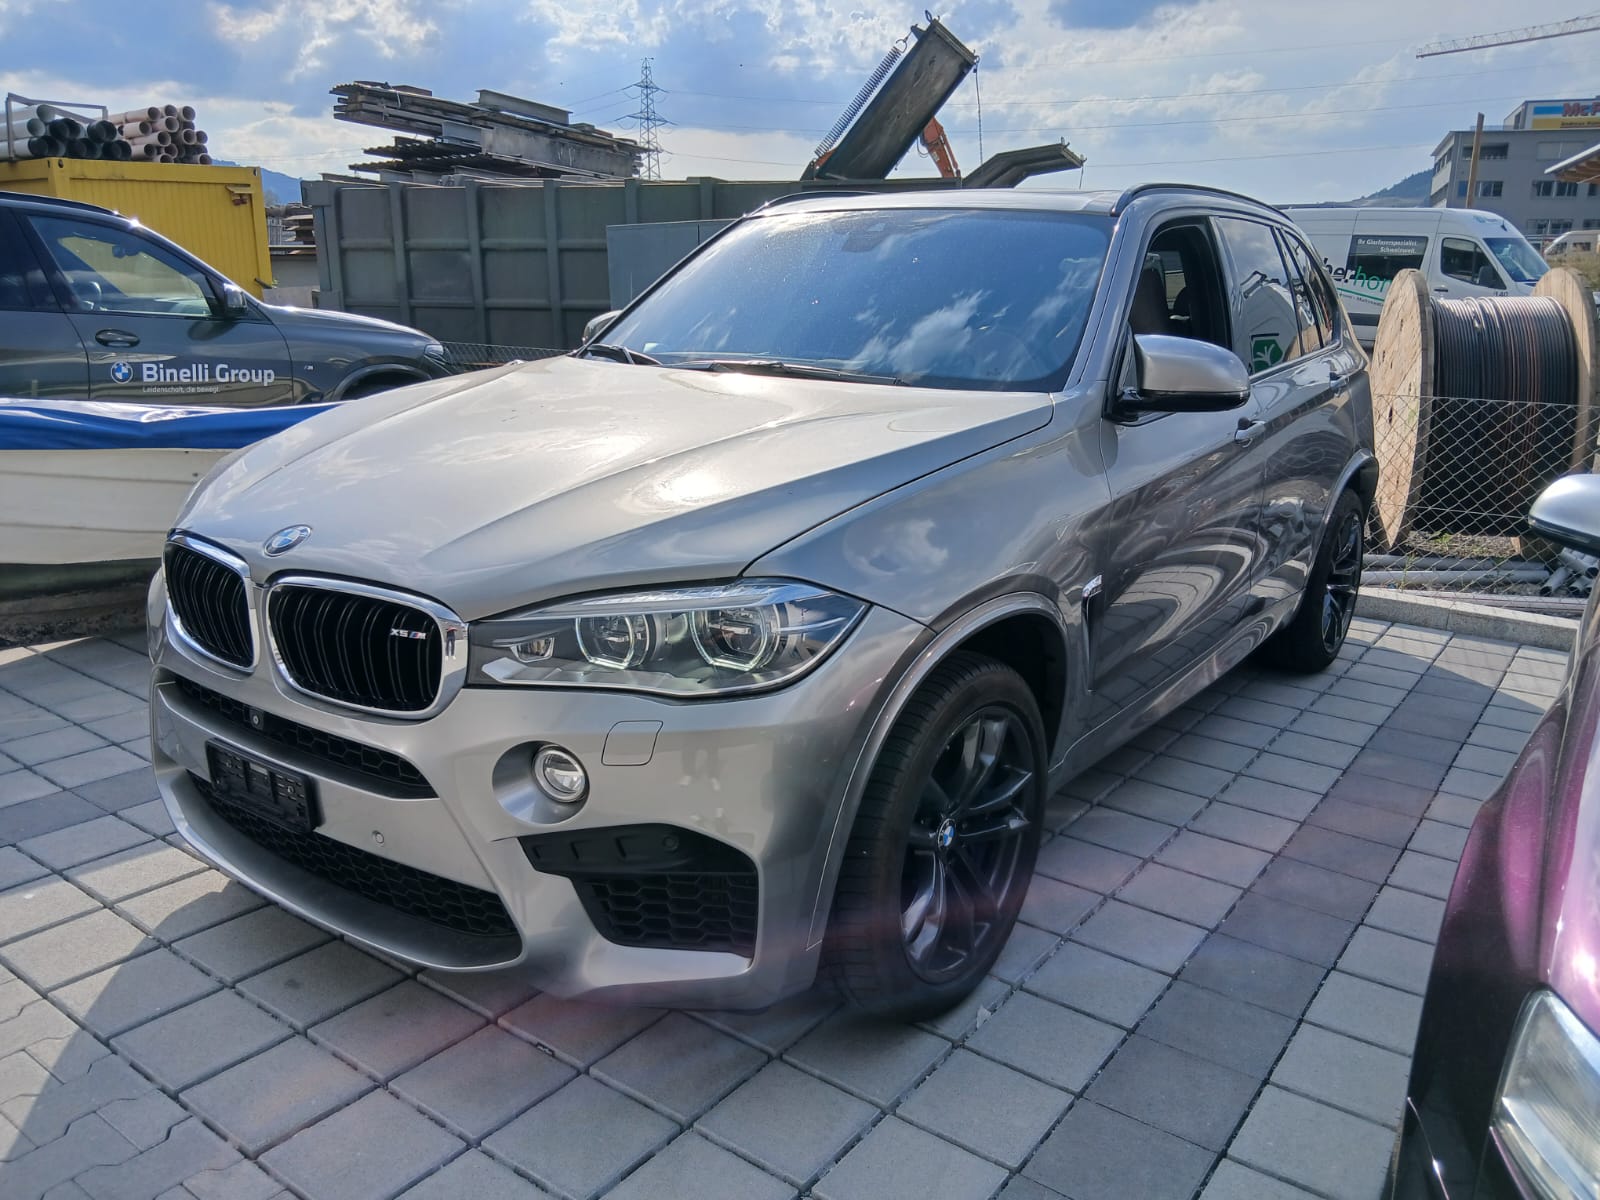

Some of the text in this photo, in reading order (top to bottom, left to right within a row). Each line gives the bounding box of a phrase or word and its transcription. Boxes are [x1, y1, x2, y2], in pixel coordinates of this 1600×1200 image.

[142, 363, 275, 387] Binelli Group
[390, 628, 409, 638] X5
